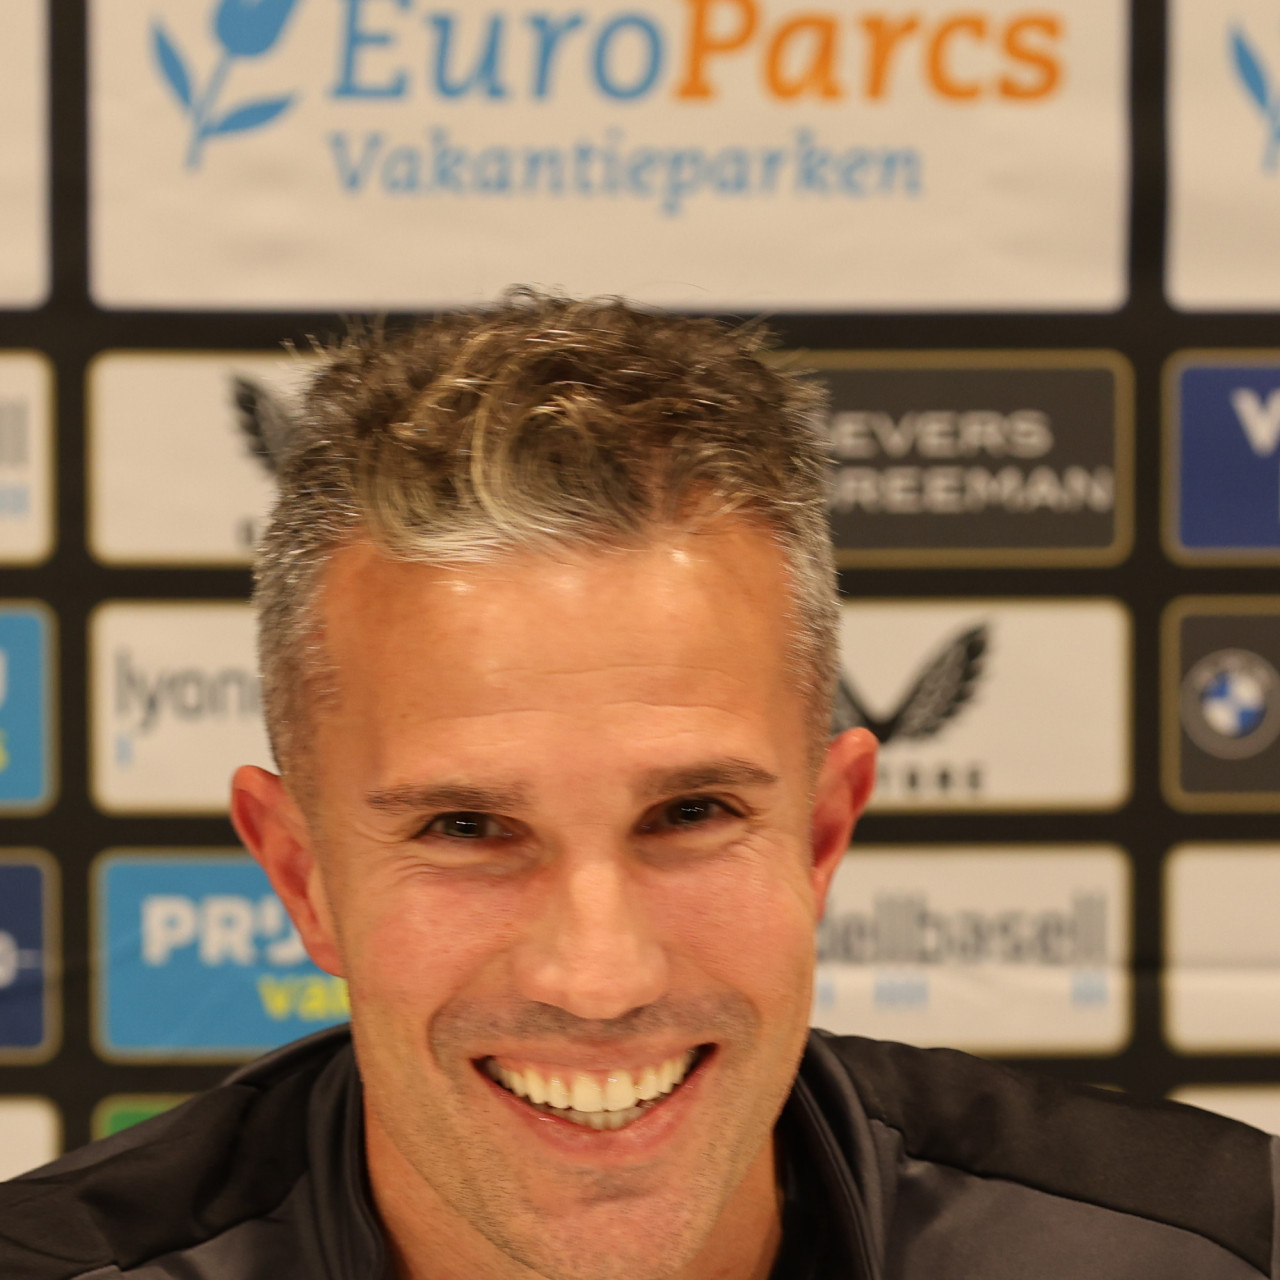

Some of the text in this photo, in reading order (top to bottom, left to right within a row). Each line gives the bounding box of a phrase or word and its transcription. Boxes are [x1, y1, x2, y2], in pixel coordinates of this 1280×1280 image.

[329, 0, 1066, 103] EuroParcs
[329, 130, 923, 214] Vakantieparken
[818, 410, 1053, 460] EVERS
[820, 465, 1114, 515] REEMAN
